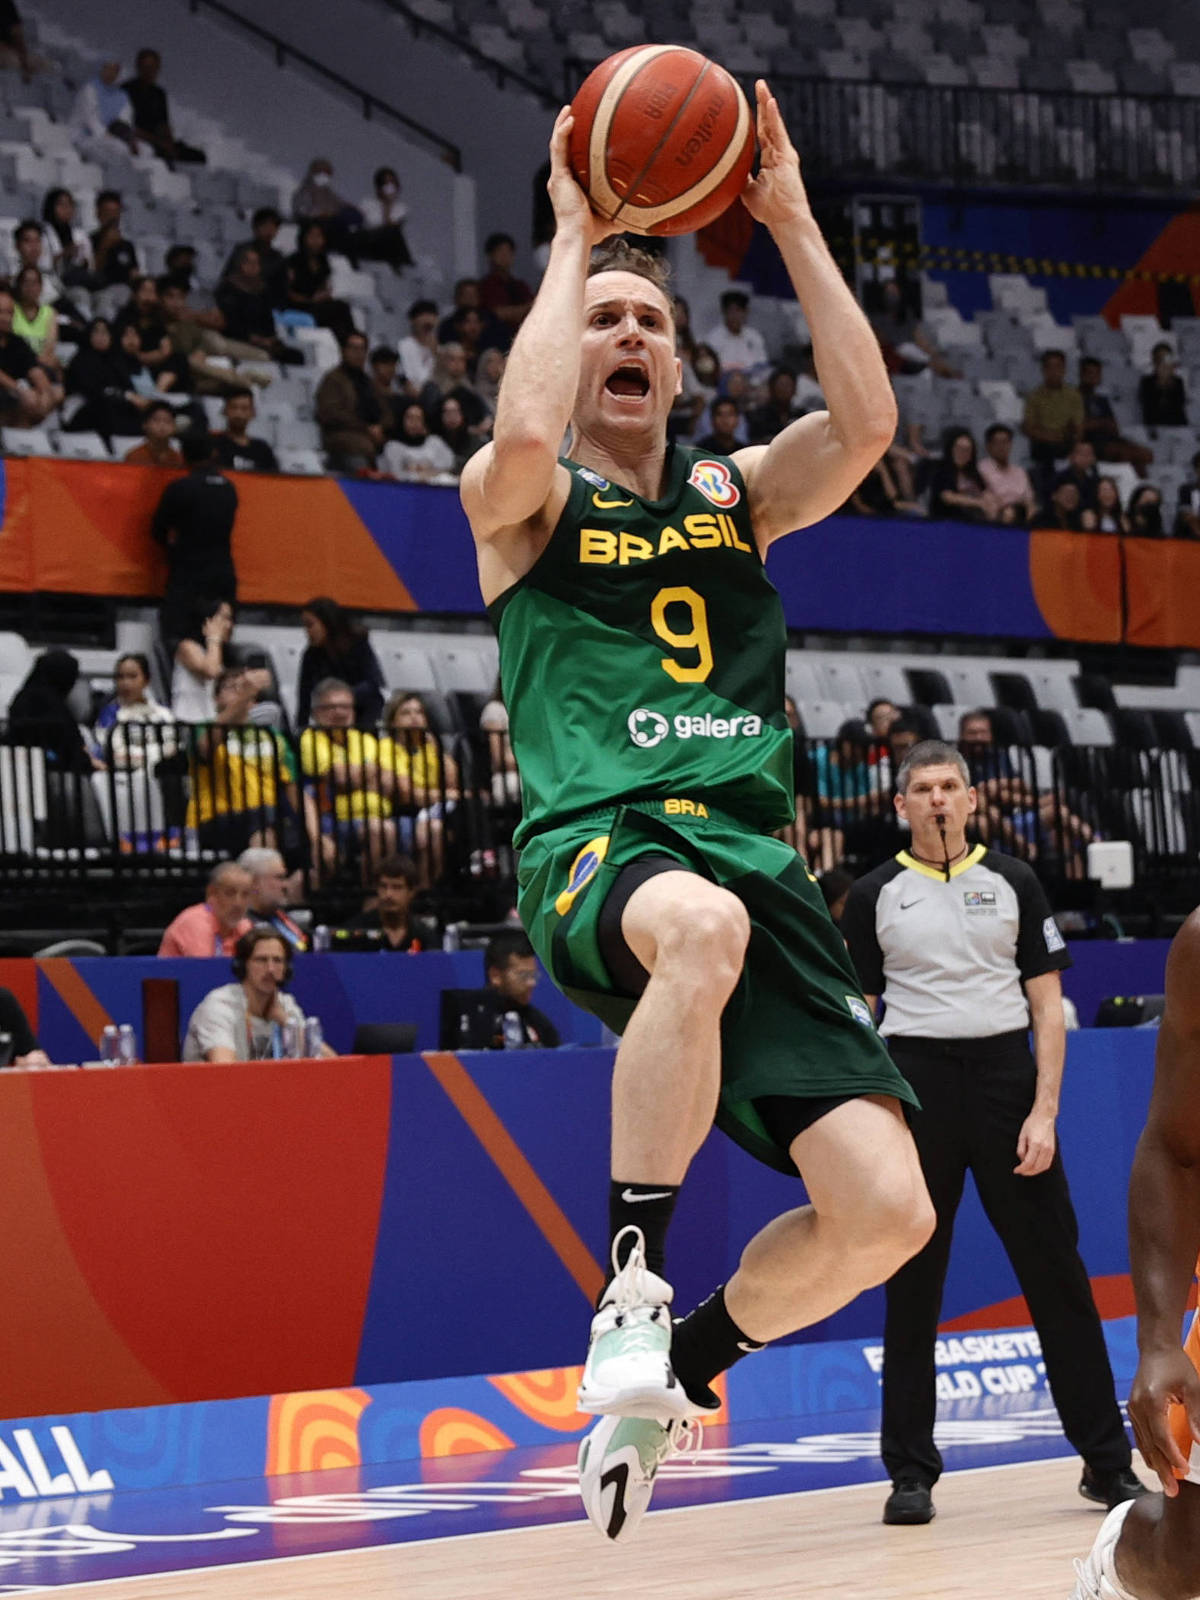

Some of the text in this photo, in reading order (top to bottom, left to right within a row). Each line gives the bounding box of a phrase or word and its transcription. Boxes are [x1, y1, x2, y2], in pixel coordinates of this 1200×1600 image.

[676, 93, 725, 167] molten
[579, 513, 752, 566] BRASIL
[651, 586, 714, 683] 9
[673, 713, 762, 739] galera
[664, 798, 709, 819] BRA
[934, 1330, 1043, 1369] BASKETB
[935, 1370, 982, 1400] RLD
[981, 1364, 1037, 1396] CUP
